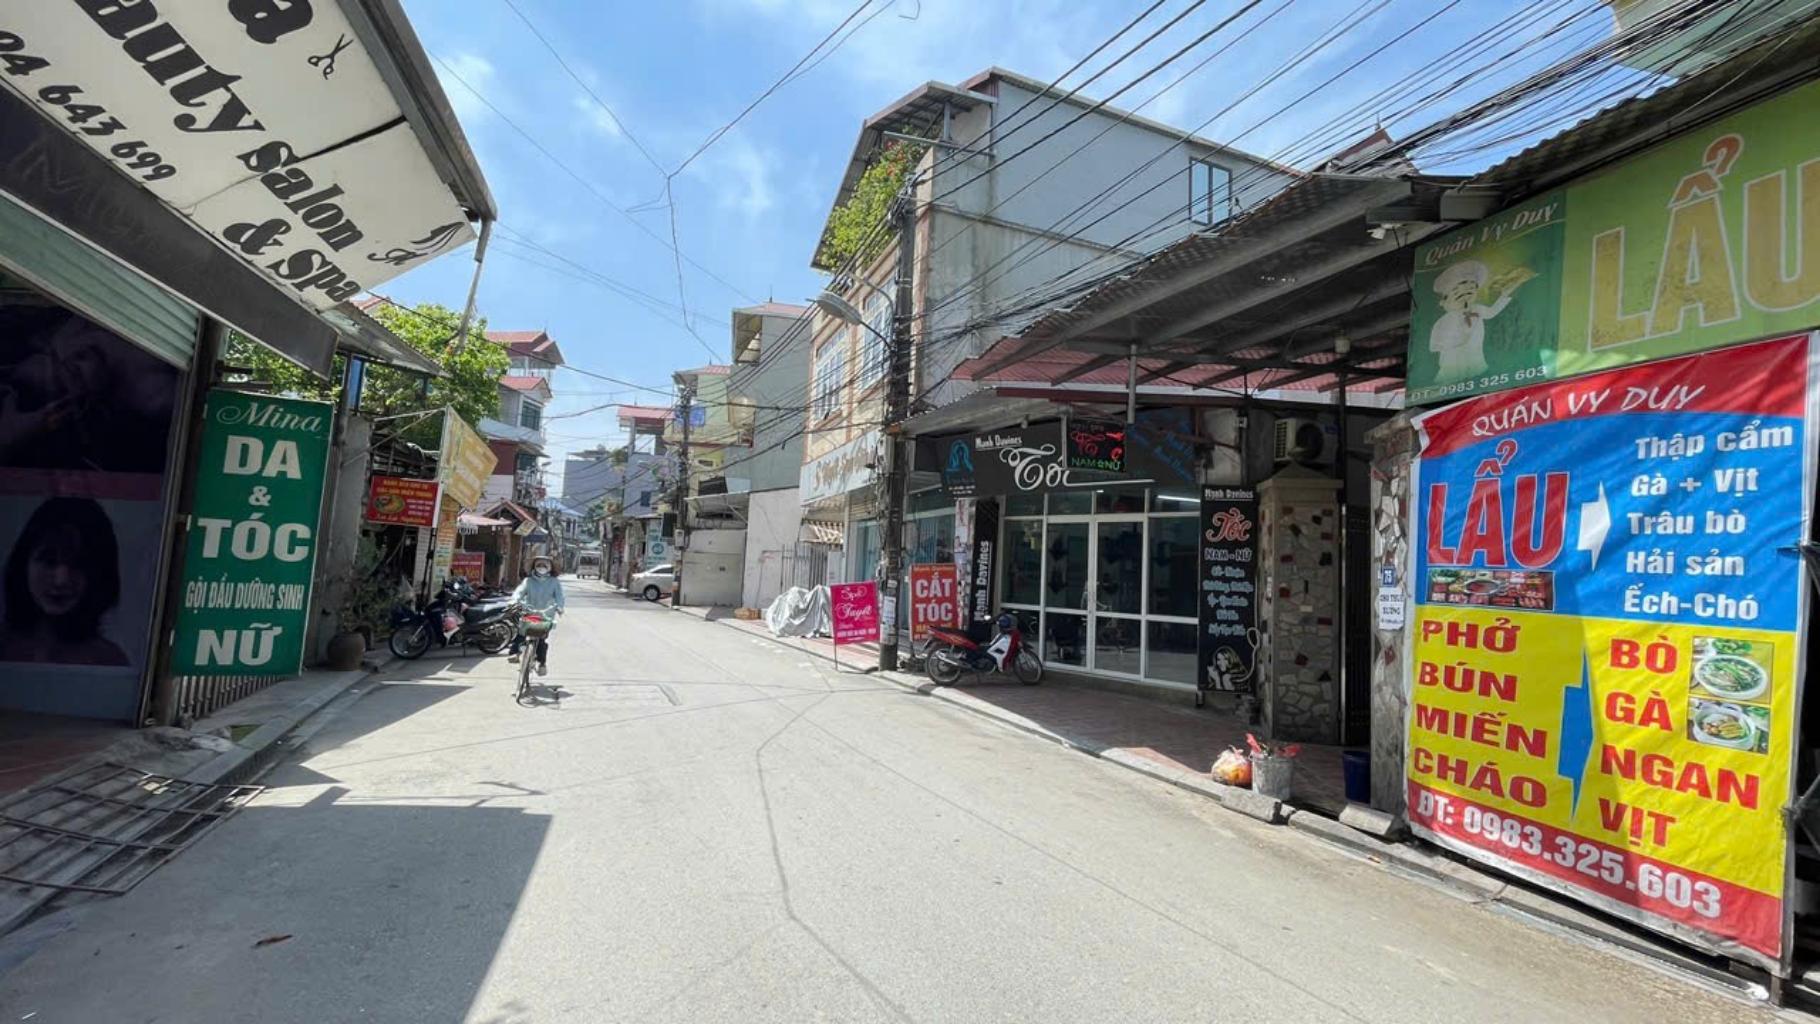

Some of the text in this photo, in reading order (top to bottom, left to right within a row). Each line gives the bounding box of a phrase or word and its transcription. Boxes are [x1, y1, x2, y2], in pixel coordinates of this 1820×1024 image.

[38, 85, 127, 137] 643
[110, 140, 177, 181] 699
[236, 141, 364, 252] Salon
[1425, 236, 1475, 266] Quán
[1511, 202, 1559, 231] Duy
[223, 218, 361, 302] & Spa
[1479, 373, 1510, 388] 325
[1514, 365, 1546, 381] 603
[215, 402, 322, 433] Mina
[1472, 384, 1706, 438] QUÁN VY DUY
[222, 434, 302, 480] DA
[1634, 419, 1793, 462] Thập cẩm
[248, 485, 272, 507] &
[1427, 438, 1570, 570] LẨU
[1630, 467, 1760, 498] Gà + Vịt
[197, 513, 311, 563] TÓC
[1205, 507, 1252, 542] Tóc
[1626, 508, 1747, 536] Trâu bò
[1203, 547, 1229, 561] NAM
[1626, 546, 1745, 577] Hải sản
[276, 583, 305, 611] SINH
[915, 599, 953, 622] TÓC
[1623, 583, 1760, 620] Ếch-Chó
[195, 621, 283, 666] NỮ
[1421, 617, 1521, 654] PHỞ
[1608, 634, 1679, 675] BÒ
[1417, 660, 1519, 703] BÚN
[1414, 703, 1549, 759] MIẾN
[1603, 690, 1674, 732] GÀ
[1413, 746, 1548, 808] CHÁO
[1600, 743, 1760, 811] NGAN
[1597, 797, 1677, 848] VỊT
[1461, 804, 1723, 919] 0983.325.603
